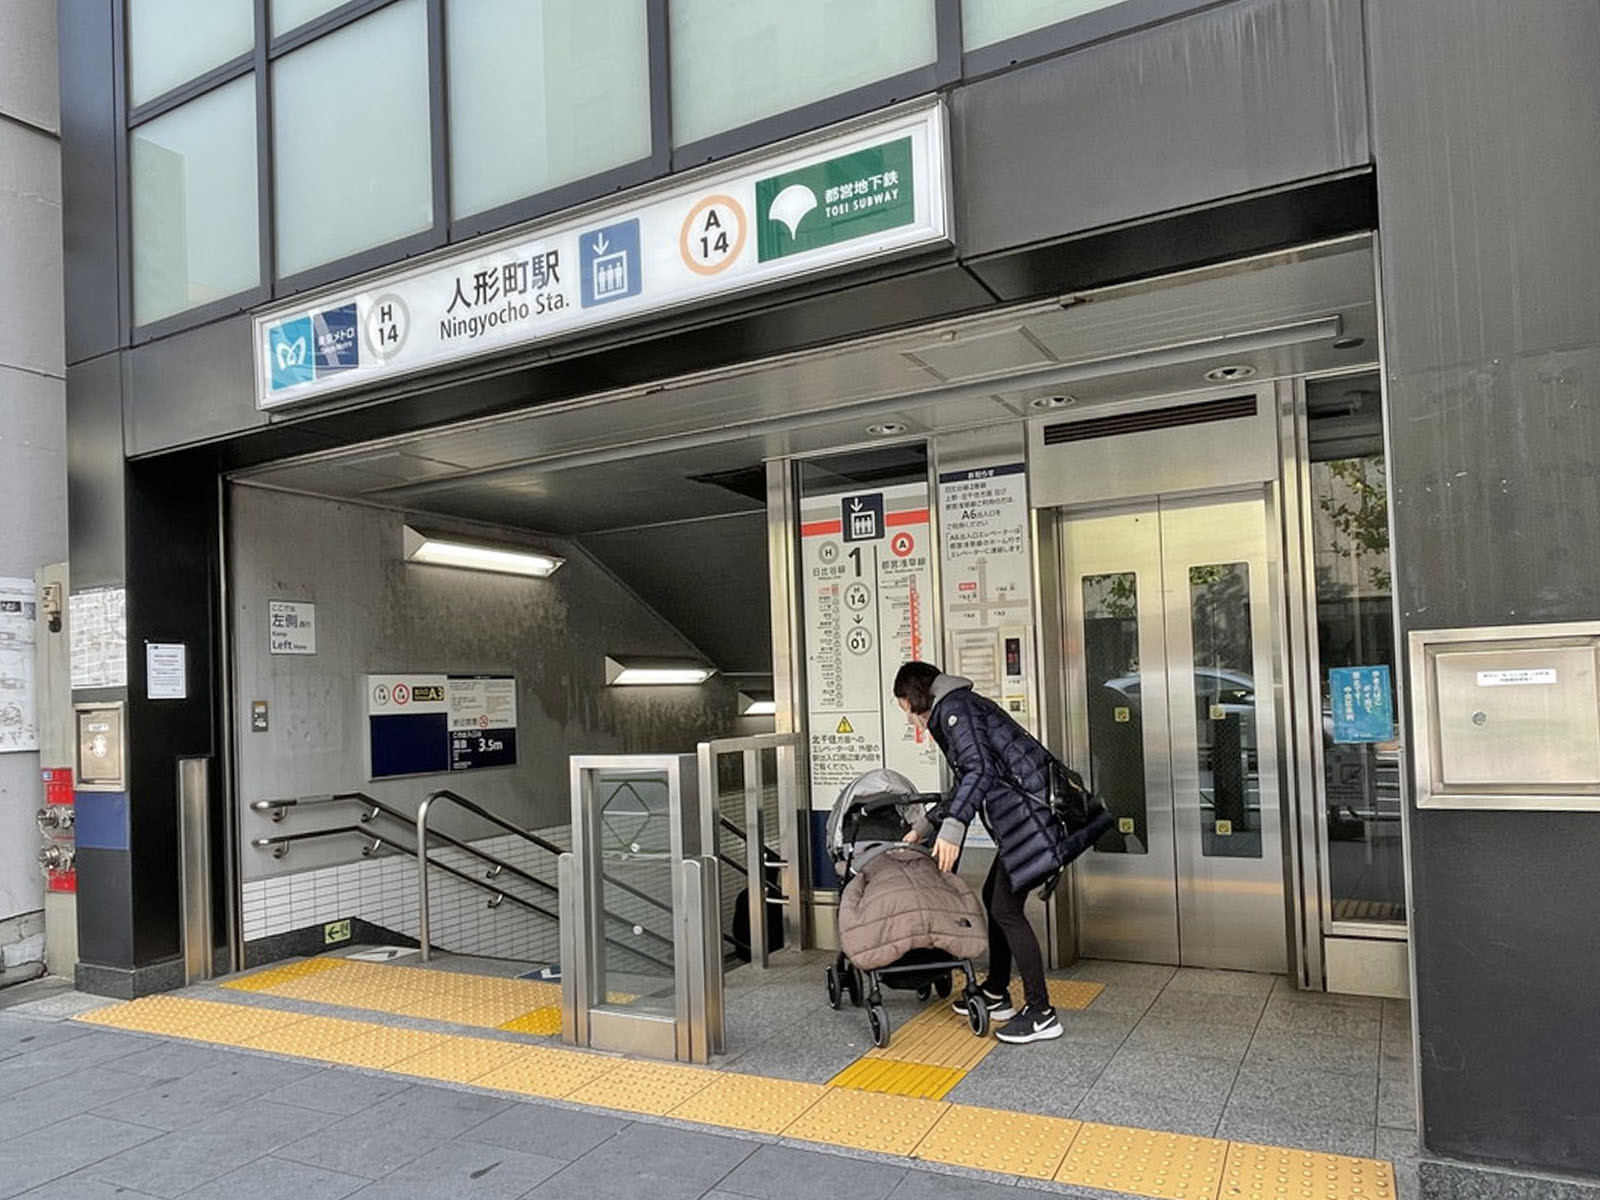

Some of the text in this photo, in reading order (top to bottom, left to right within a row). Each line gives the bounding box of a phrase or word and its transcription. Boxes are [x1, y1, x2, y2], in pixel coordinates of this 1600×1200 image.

[825, 169, 899, 203] 都営地下鉄
[825, 189, 899, 219] TOEI SUBWAY
[704, 209, 721, 232] A
[700, 232, 730, 258] 14
[446, 250, 561, 314] 人形町駅
[380, 304, 393, 323] H
[439, 292, 570, 340] Ningyocho Sta.
[378, 323, 399, 347] 14
[825, 548, 833, 556] H
[899, 540, 907, 549] A
[848, 546, 862, 577] 1
[850, 593, 866, 606] 14
[272, 639, 293, 650] Left
[850, 637, 867, 650] 01
[478, 738, 503, 752] 3.5m
